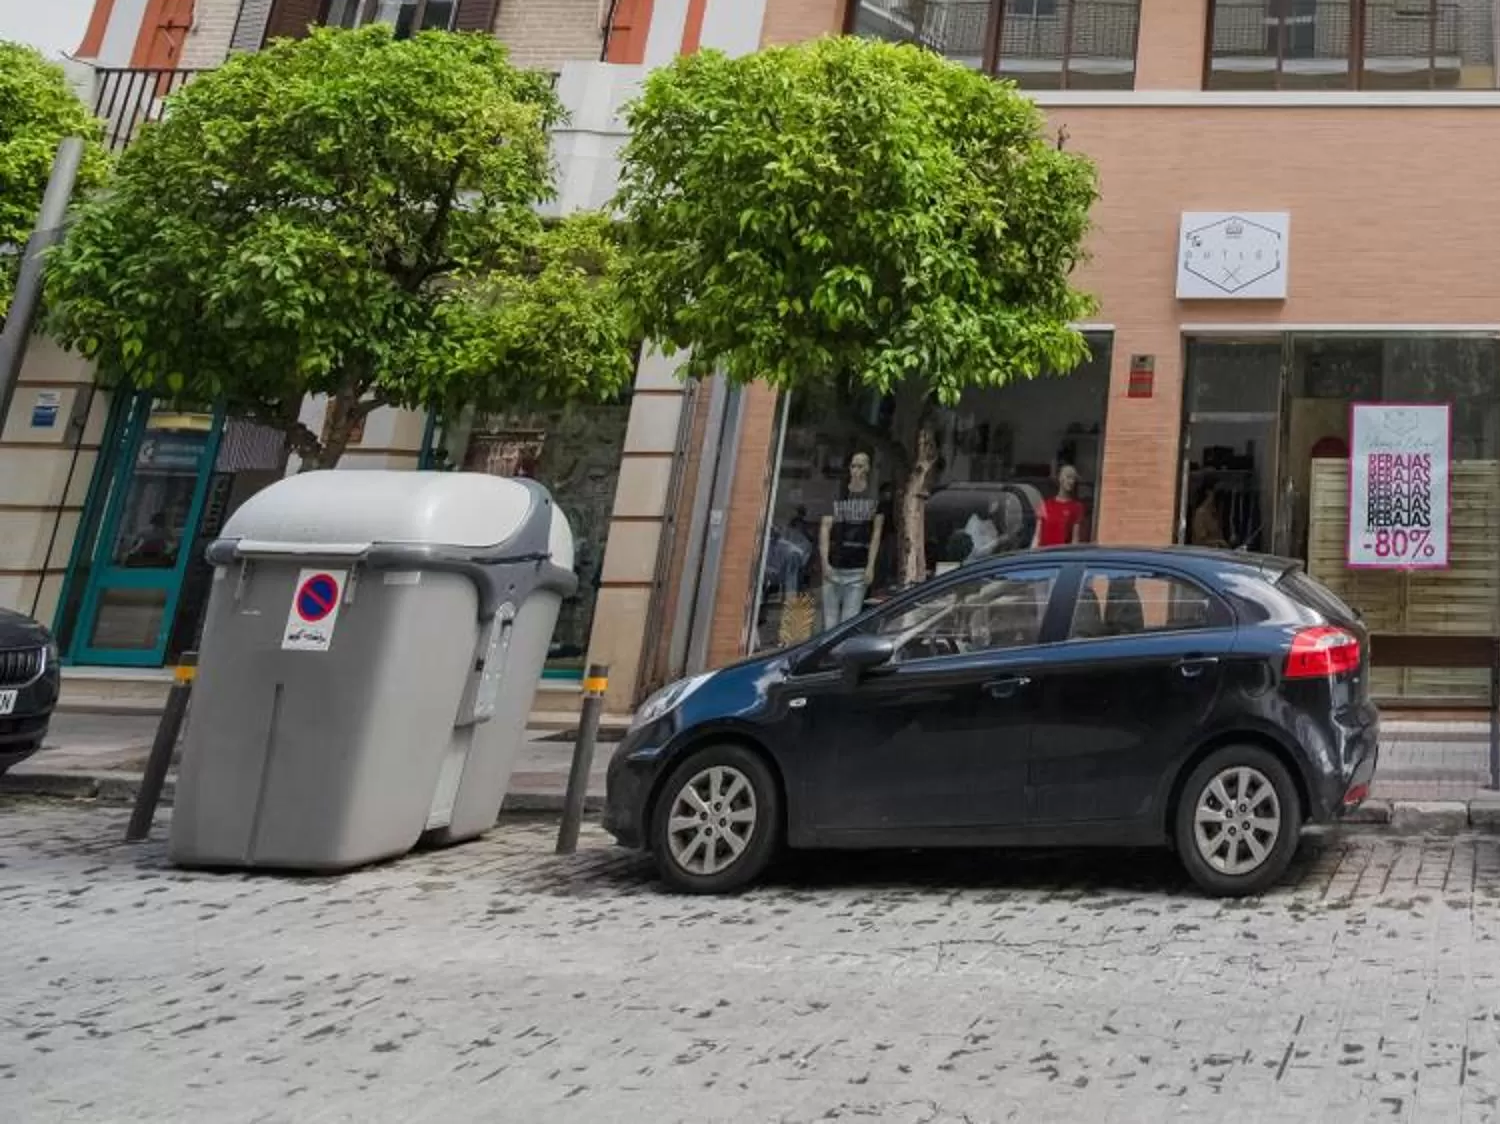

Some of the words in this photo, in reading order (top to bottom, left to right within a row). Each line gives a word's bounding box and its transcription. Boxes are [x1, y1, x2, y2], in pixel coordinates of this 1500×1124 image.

[1367, 453, 1431, 469] REBAJAS
[1367, 510, 1431, 527] REBAJAS
[1363, 528, 1435, 559] -80%
